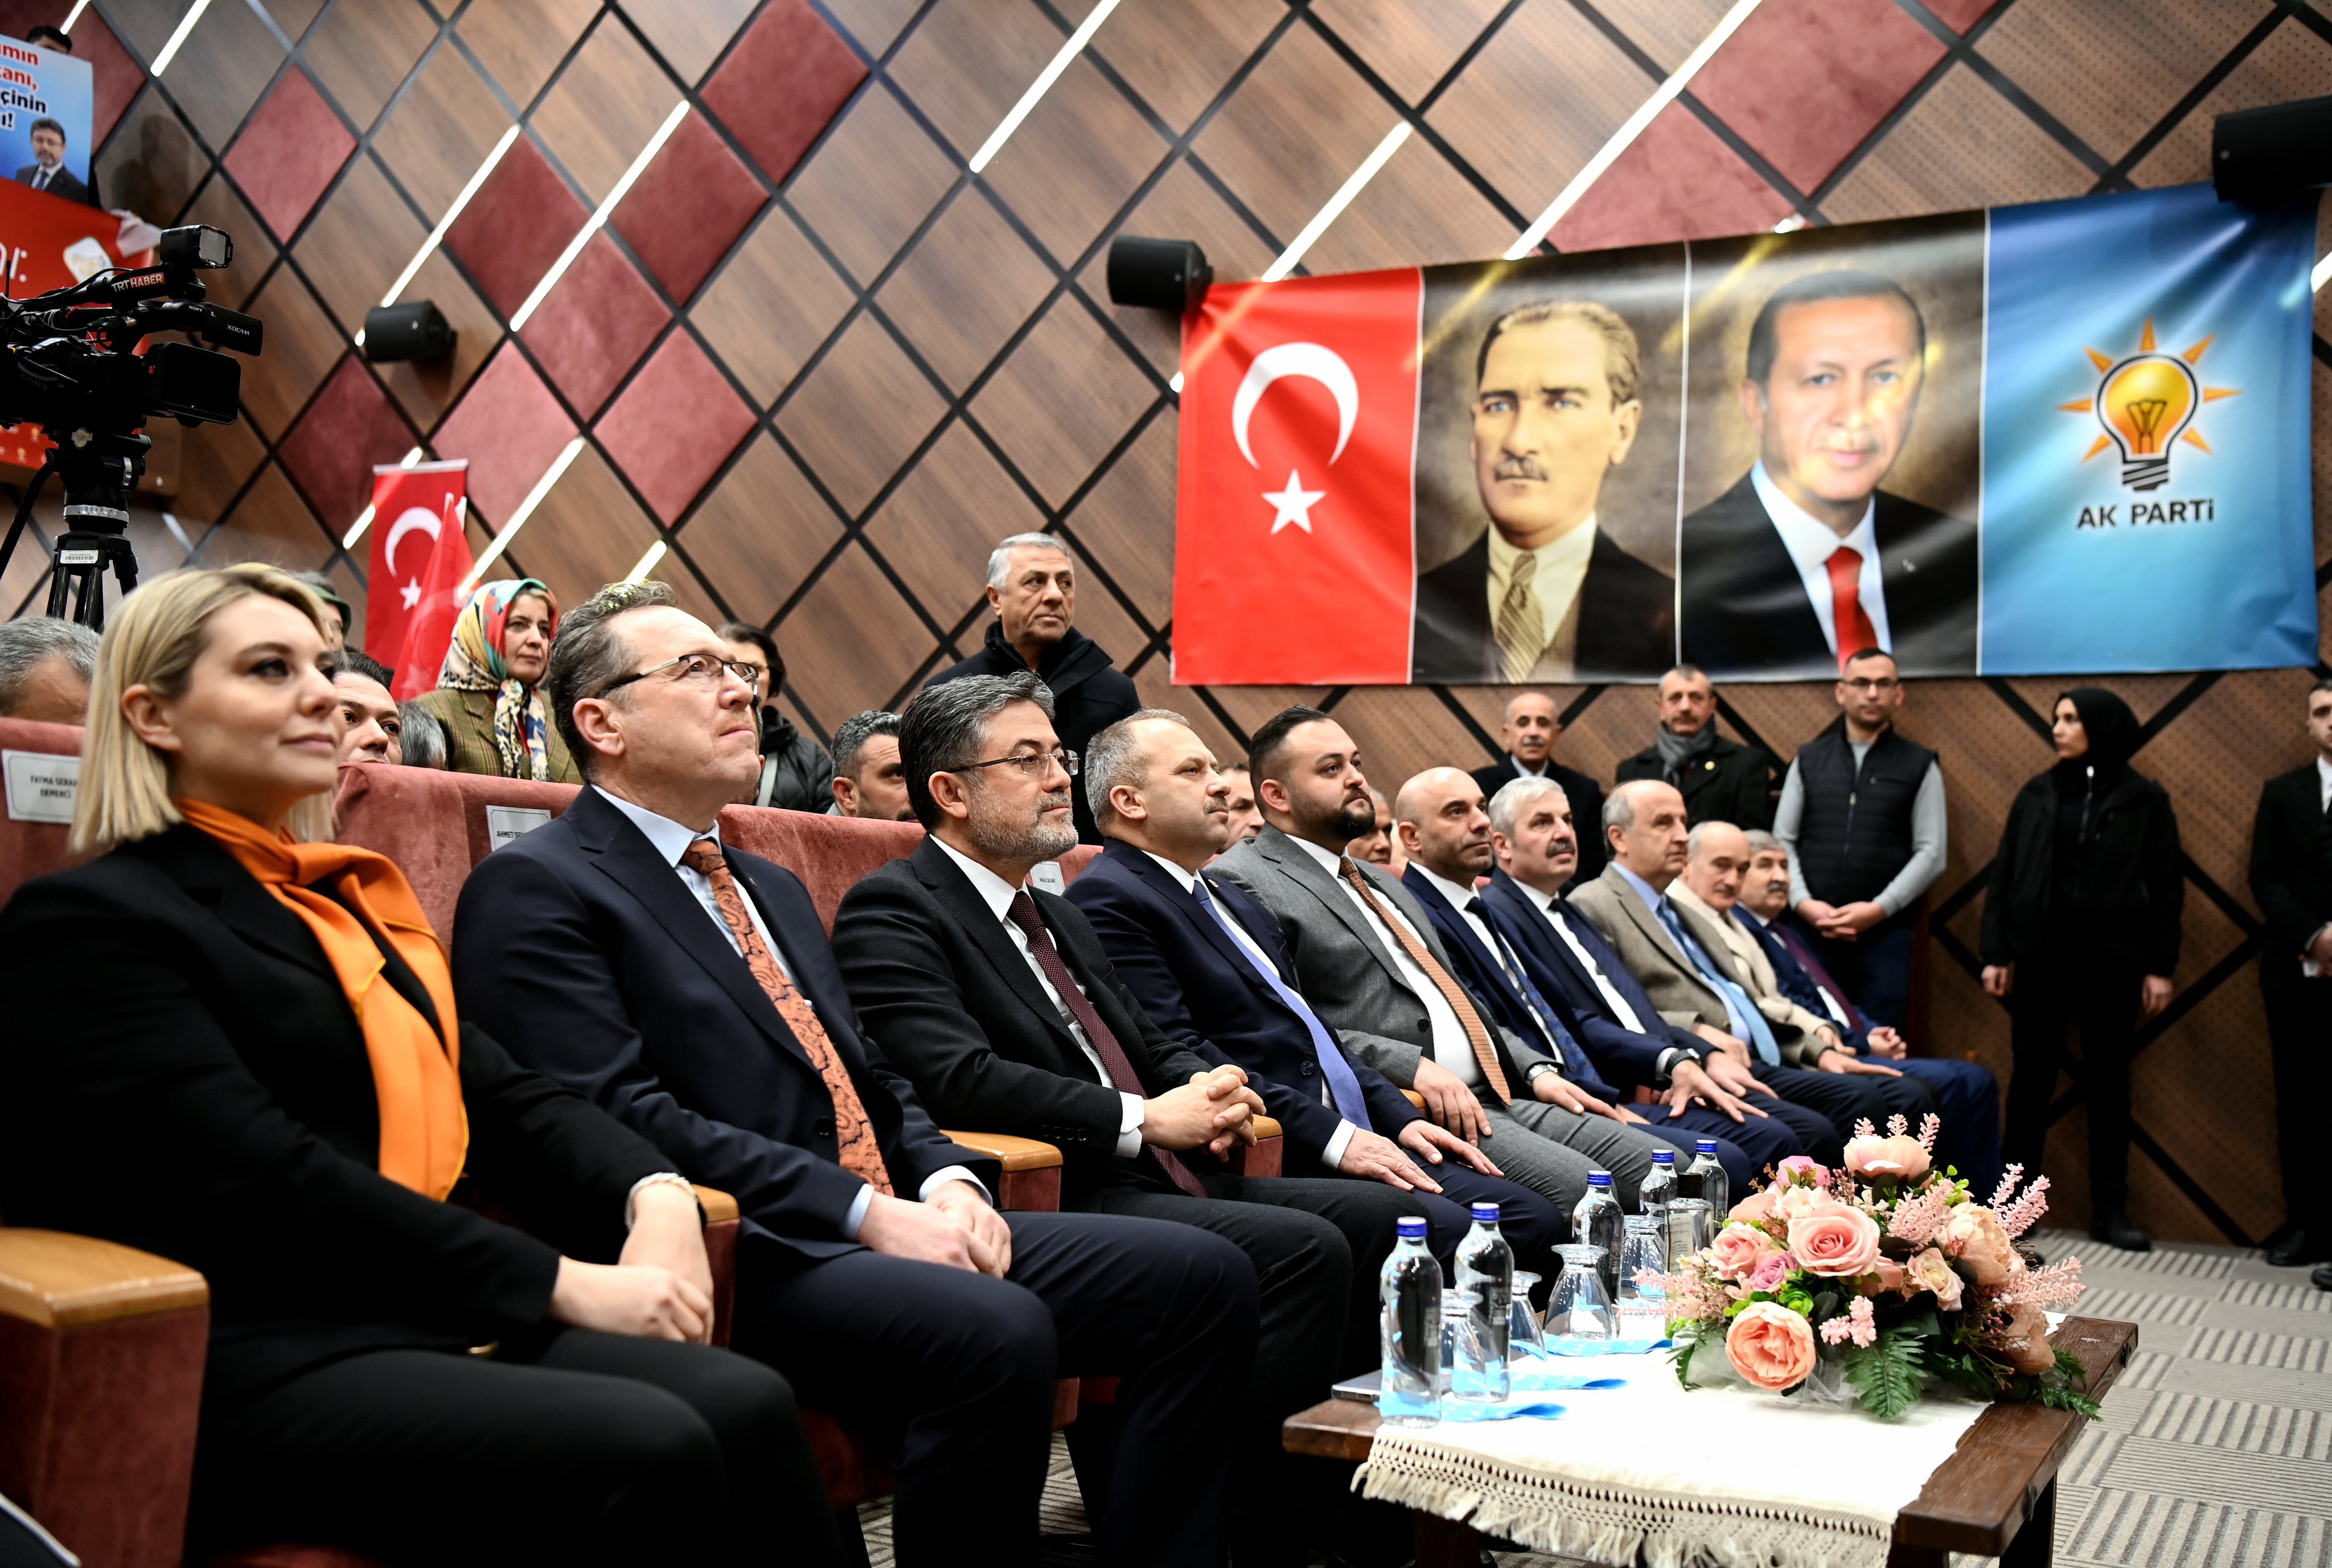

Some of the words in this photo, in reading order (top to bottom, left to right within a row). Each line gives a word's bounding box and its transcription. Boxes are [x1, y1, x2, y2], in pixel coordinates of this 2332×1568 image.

[0, 44, 38, 65] mın
[0, 67, 36, 89] anı,
[111, 280, 130, 292] TRT
[130, 274, 163, 288] HABER
[227, 324, 249, 336] XDCAM
[20, 373, 49, 390] SONY
[2077, 504, 2117, 529] AK
